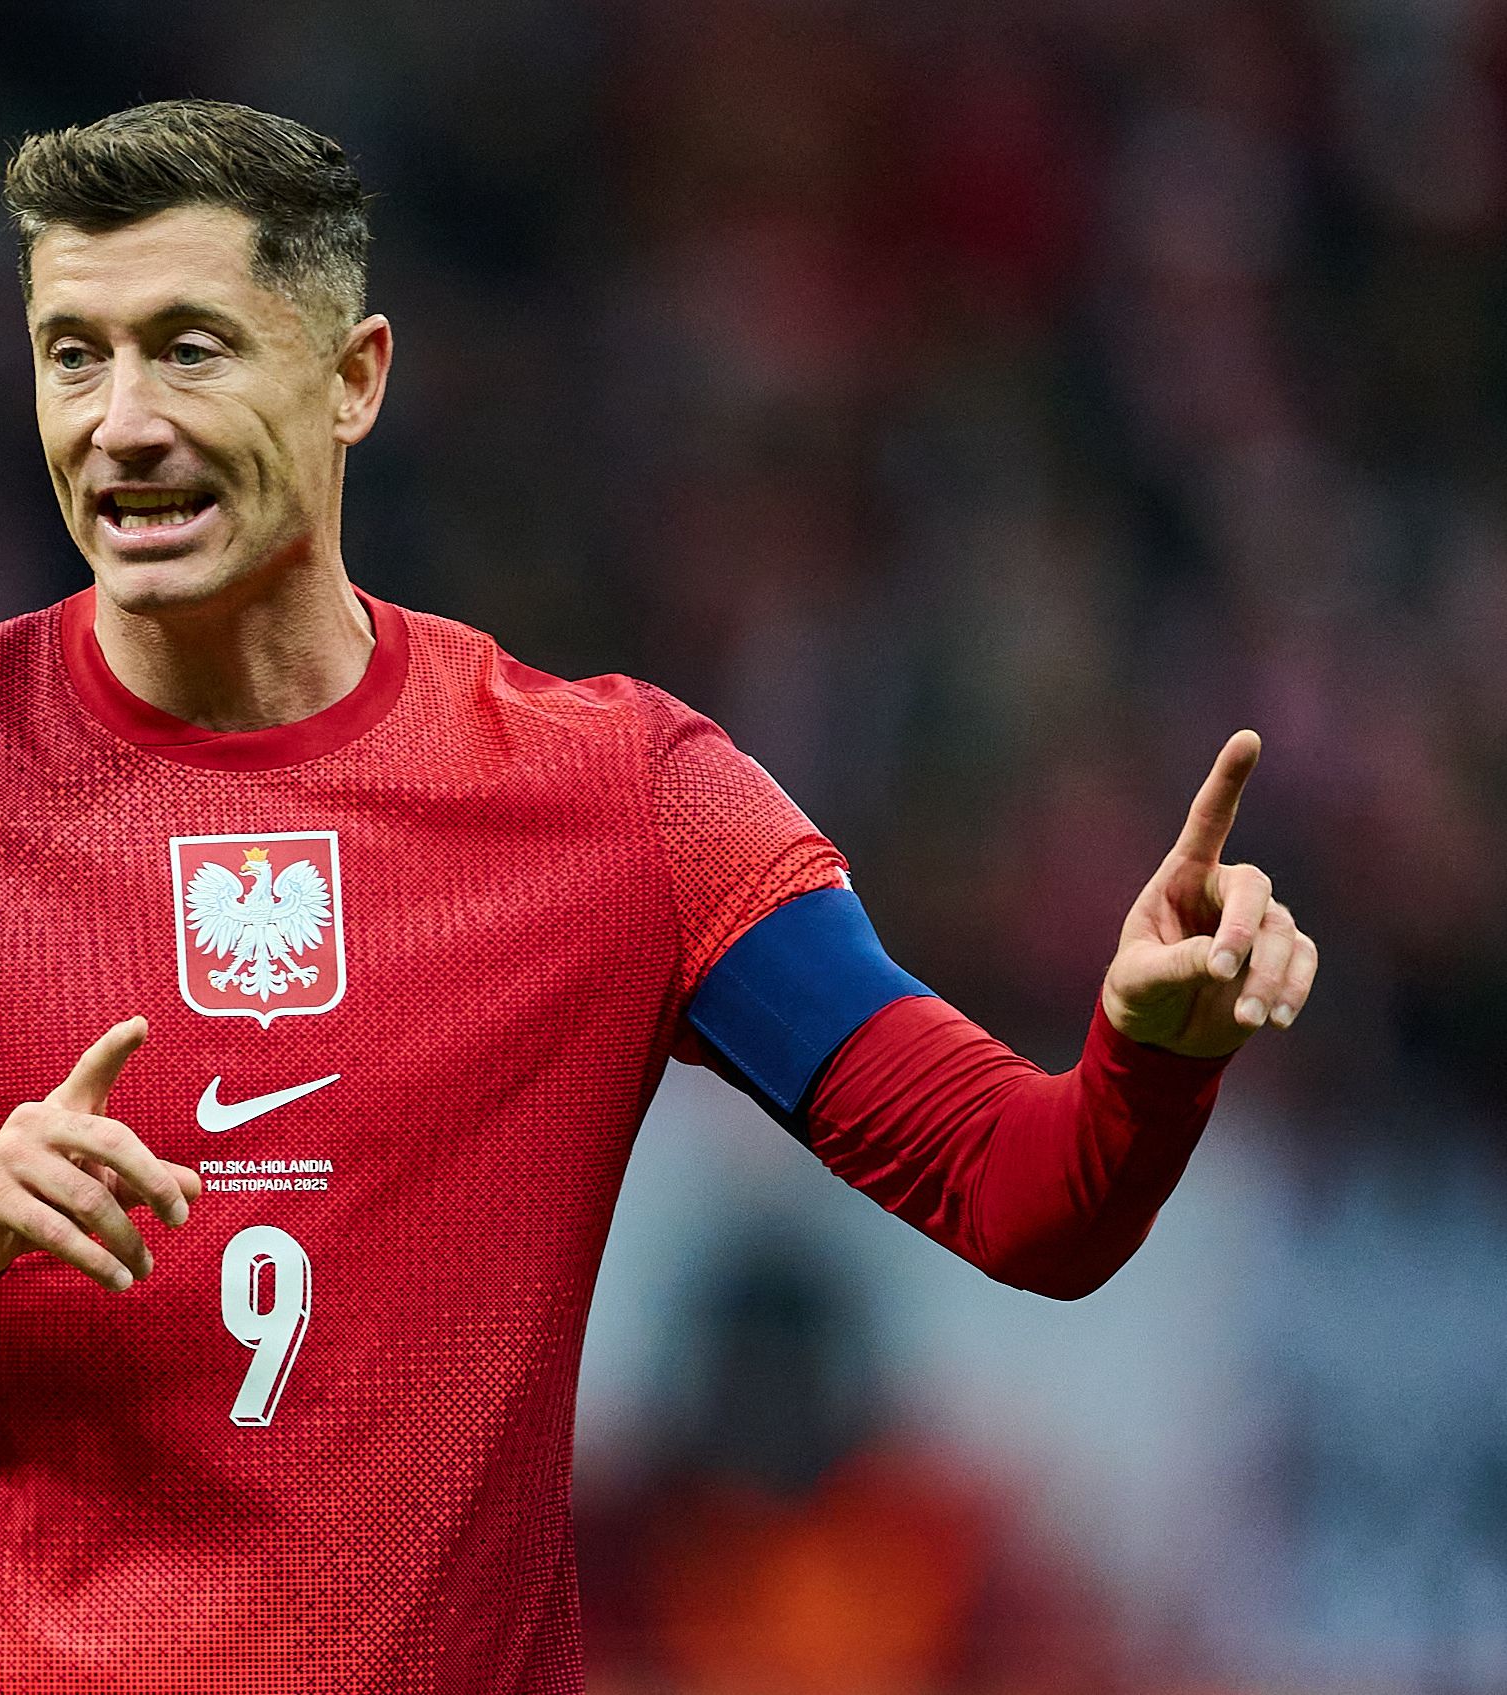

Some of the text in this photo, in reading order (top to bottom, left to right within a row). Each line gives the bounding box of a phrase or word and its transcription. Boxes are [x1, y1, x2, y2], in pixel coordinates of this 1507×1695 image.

[199, 1160, 333, 1174] POLSKA-HOLANDIA
[206, 1178, 328, 1192] 14 LISTOPADA 2025
[221, 1225, 312, 1427] 9
